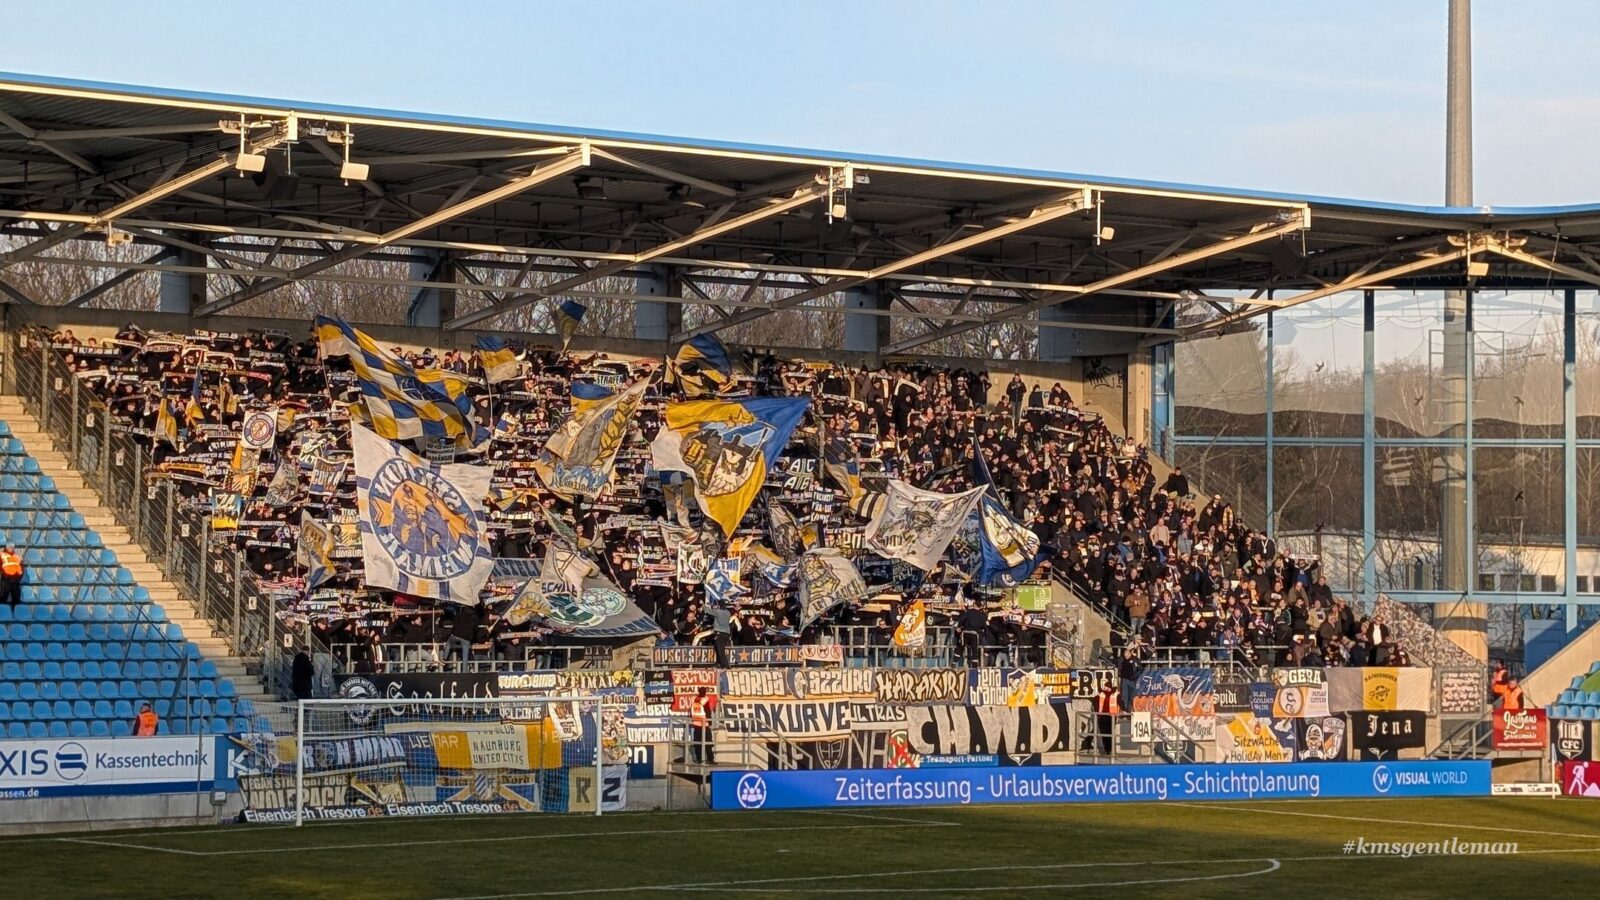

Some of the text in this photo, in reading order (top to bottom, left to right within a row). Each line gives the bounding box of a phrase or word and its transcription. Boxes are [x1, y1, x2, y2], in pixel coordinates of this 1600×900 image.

[751, 649, 772, 662] MIT
[1288, 668, 1321, 684] GERA
[875, 670, 967, 703] HARAKIRI
[724, 701, 850, 734] SÜDKURVE
[850, 704, 905, 722] ULTRAS
[1134, 721, 1150, 738] 19A
[1367, 714, 1412, 737] Jena
[1561, 740, 1580, 749] CFC
[96, 750, 208, 769] Kassentechnik
[835, 775, 972, 804] Zeiterfassung
[990, 772, 1168, 801] Urlaubsverwaltung
[1184, 769, 1320, 798] Schichtplanung
[1395, 771, 1468, 785] VISUAL WORLD
[244, 807, 315, 822] Eisenbach
[387, 801, 453, 816] Eisenbach
